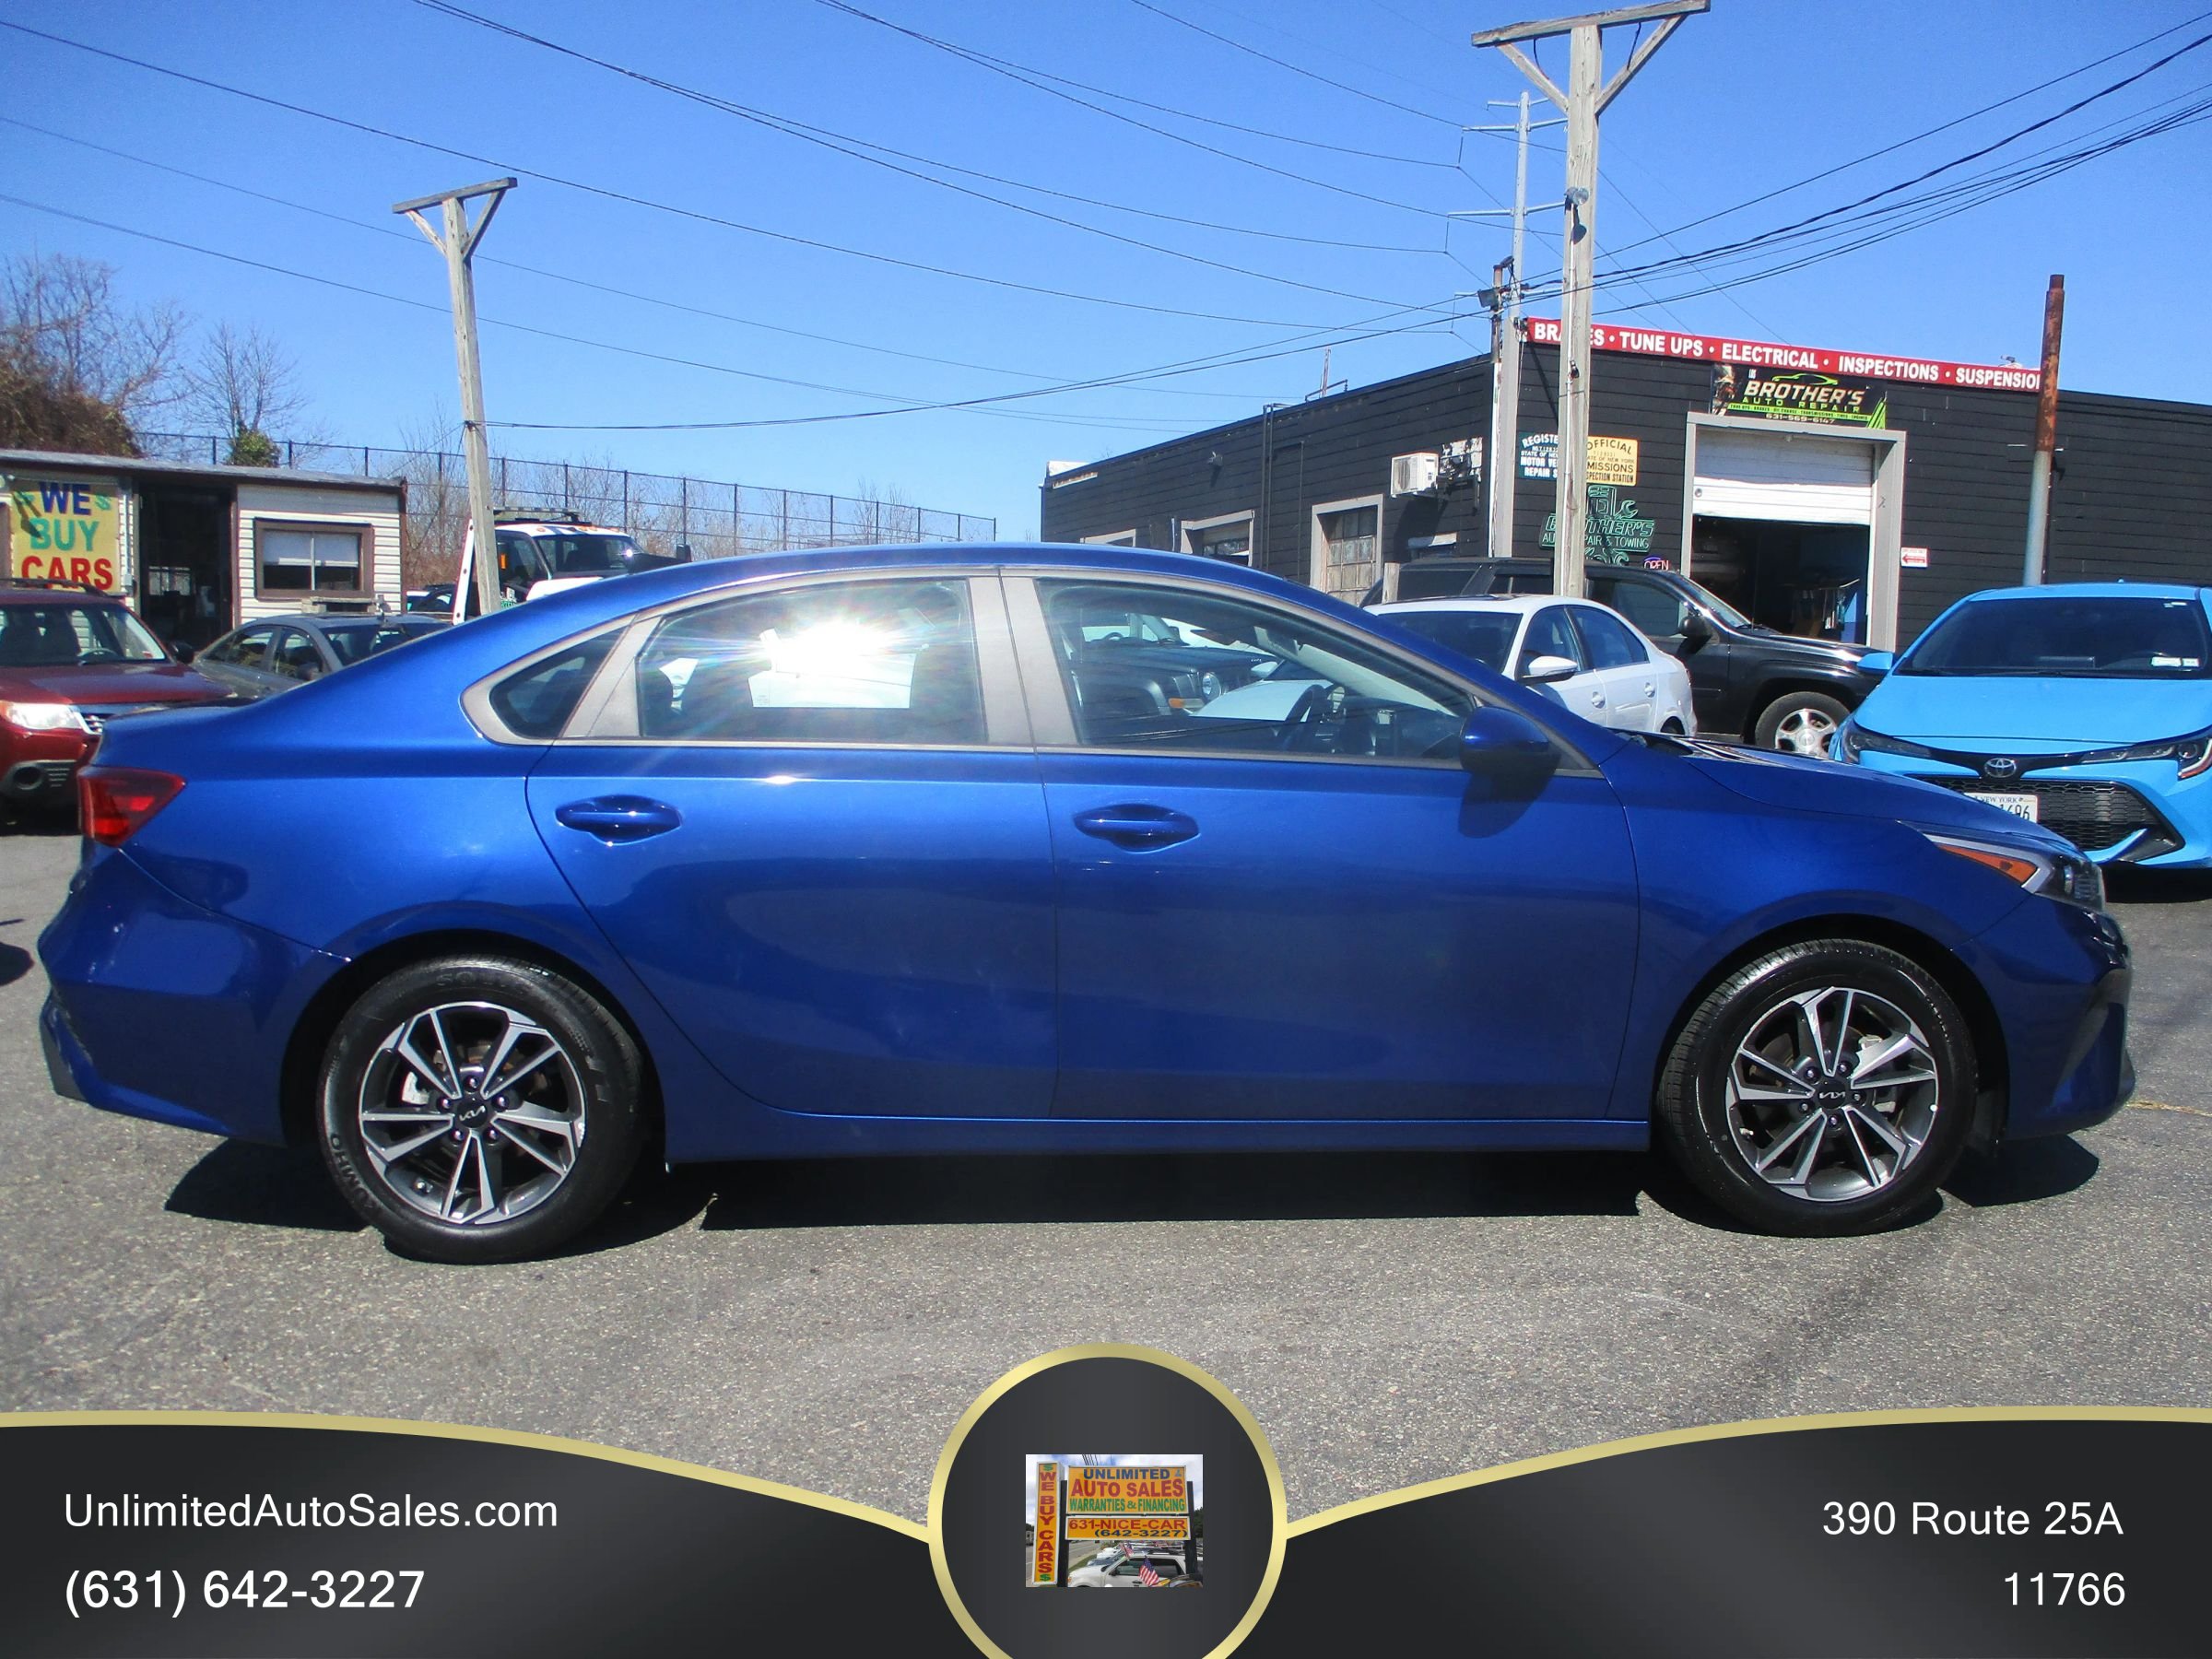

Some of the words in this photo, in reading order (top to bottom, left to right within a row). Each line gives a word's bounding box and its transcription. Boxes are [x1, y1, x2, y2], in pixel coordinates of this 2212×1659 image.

[1535, 322, 1605, 347] BRS
[1619, 331, 1666, 352] TUNE
[1670, 336, 1703, 357] UPS
[1722, 343, 1818, 369] ELECTRICAL
[1839, 356, 1939, 381] INSPECTIONS
[1956, 368, 2040, 390] SUSPENSIO
[1744, 380, 1865, 406] BROTHER'S
[1742, 396, 1783, 406] AUTO
[1798, 401, 1860, 413] REPAIR
[1522, 433, 1559, 449] REGISTE
[1587, 439, 1631, 455] OFFICIAL
[1521, 456, 1546, 466] MOTOR
[1587, 461, 1633, 474] MISSIONS
[1524, 466, 1550, 477] REPAIR
[1612, 473, 1633, 483] STATION
[39, 481, 91, 515] WE
[29, 517, 100, 552] BUY
[1615, 536, 1650, 548] TOWING
[21, 556, 112, 590] CARS
